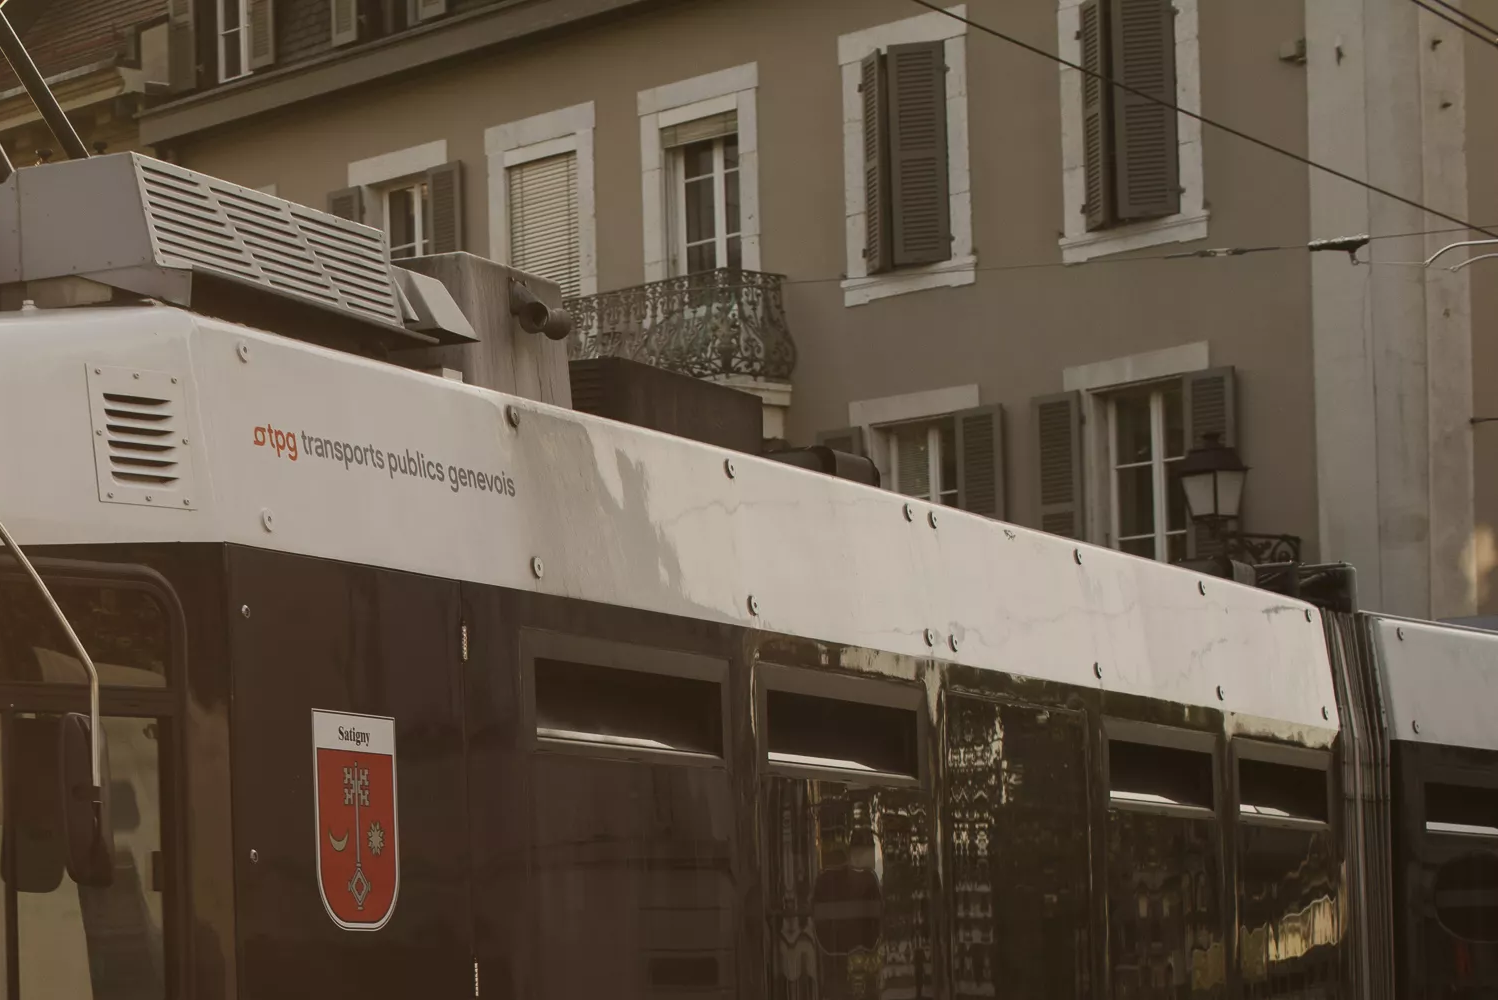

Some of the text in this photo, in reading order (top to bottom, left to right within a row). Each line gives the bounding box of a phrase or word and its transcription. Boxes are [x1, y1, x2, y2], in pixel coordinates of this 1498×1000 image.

[301, 430, 385, 471] transports
[386, 448, 445, 480] publics
[448, 465, 516, 498] genevois
[337, 725, 371, 747] Satigny
